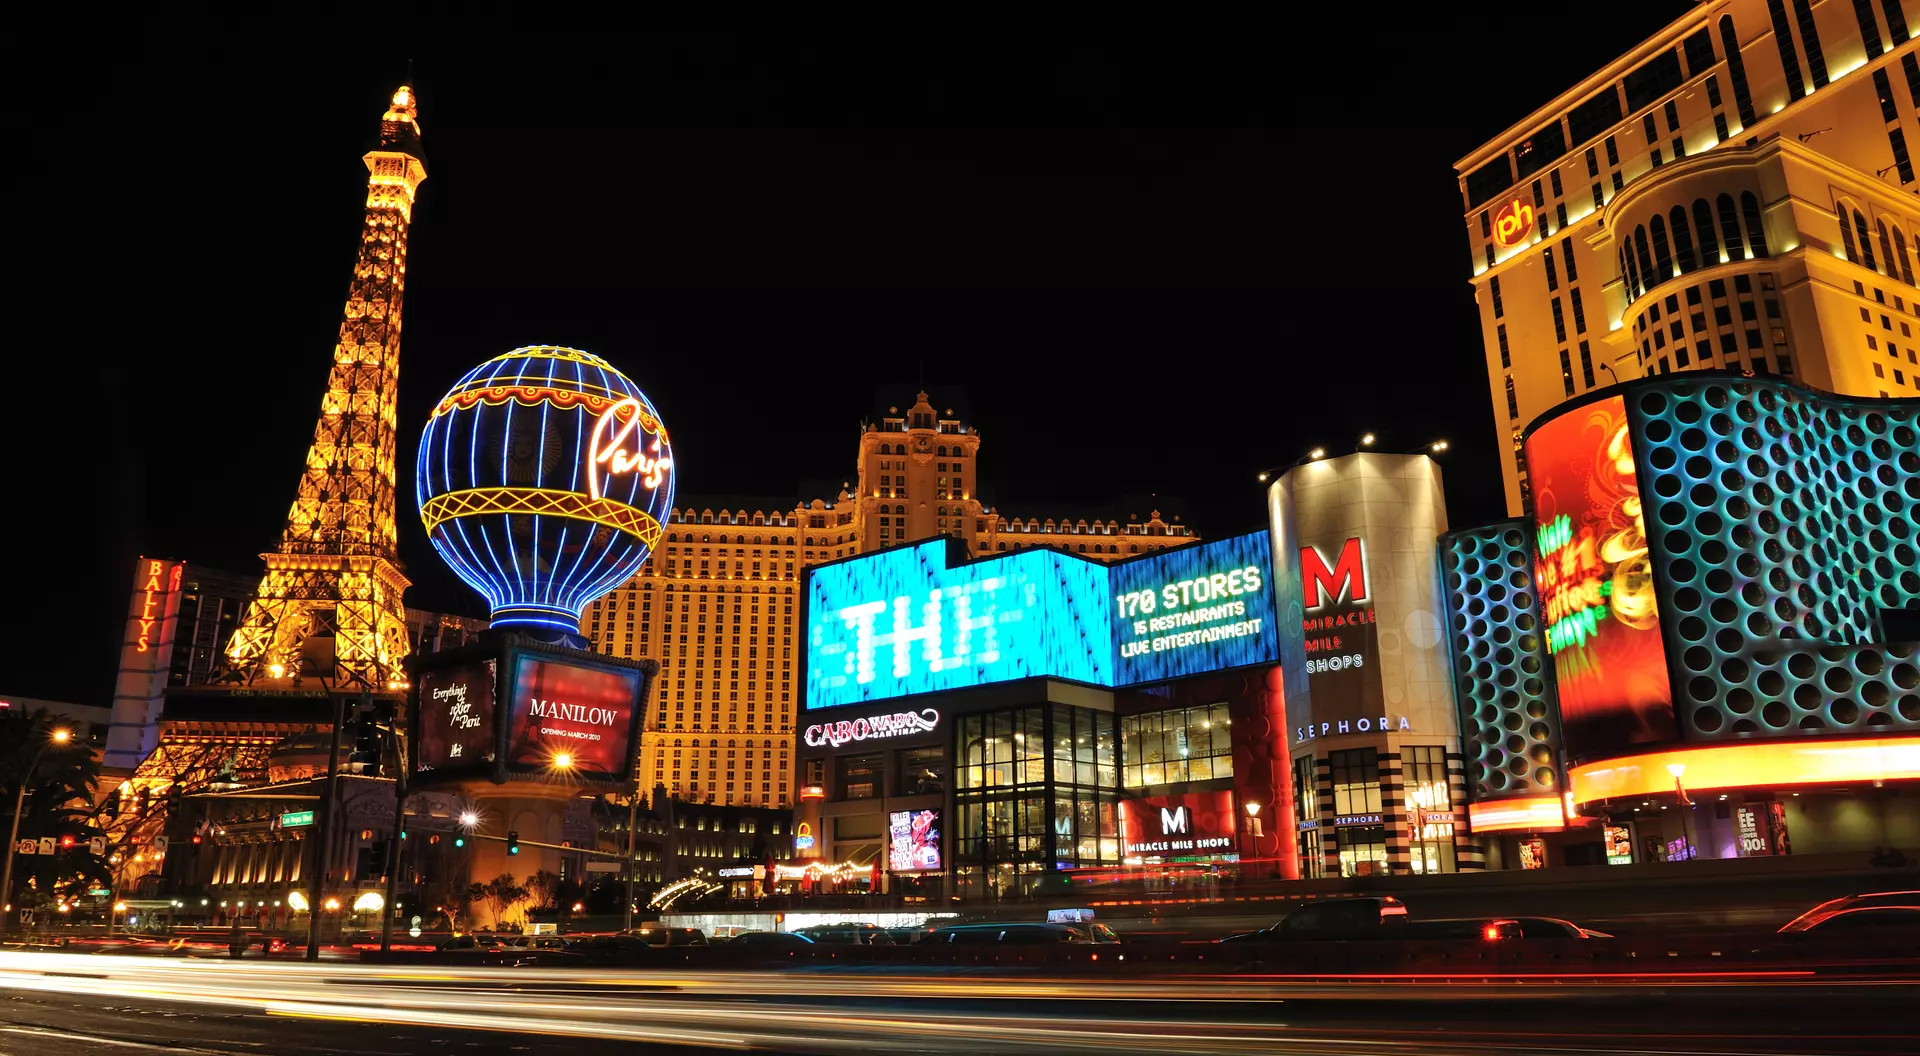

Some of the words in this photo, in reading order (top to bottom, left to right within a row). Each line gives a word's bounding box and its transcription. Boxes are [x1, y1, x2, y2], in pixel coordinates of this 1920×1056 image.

[1497, 199, 1533, 244] ph
[588, 397, 672, 501] Paris
[1300, 537, 1369, 611] M
[1116, 588, 1156, 619] 170
[1162, 565, 1261, 609] STORES
[1133, 620, 1147, 635] 15
[1150, 600, 1245, 633] RESTAURANTS
[1303, 609, 1376, 632] MIRACLE
[1121, 640, 1150, 658] LIVE
[1152, 618, 1262, 652] ENTERTAINMENT
[1304, 635, 1342, 653] MILE
[1306, 653, 1363, 673] SHOPS
[529, 699, 617, 726] MANILOW
[541, 727, 567, 737] OPENING
[567, 731, 588, 740] MARCH
[588, 733, 601, 741] 2010
[804, 717, 870, 748] CABO
[872, 727, 916, 739] CANTINA
[1297, 716, 1411, 742] SEPHORA
[1161, 806, 1185, 835] M
[1336, 815, 1380, 825] SEPHORA
[1408, 812, 1454, 824] SHORA
[1128, 842, 1169, 852] MIRACLE
[1171, 841, 1193, 850] MILE
[1197, 838, 1230, 849] SHOPS
